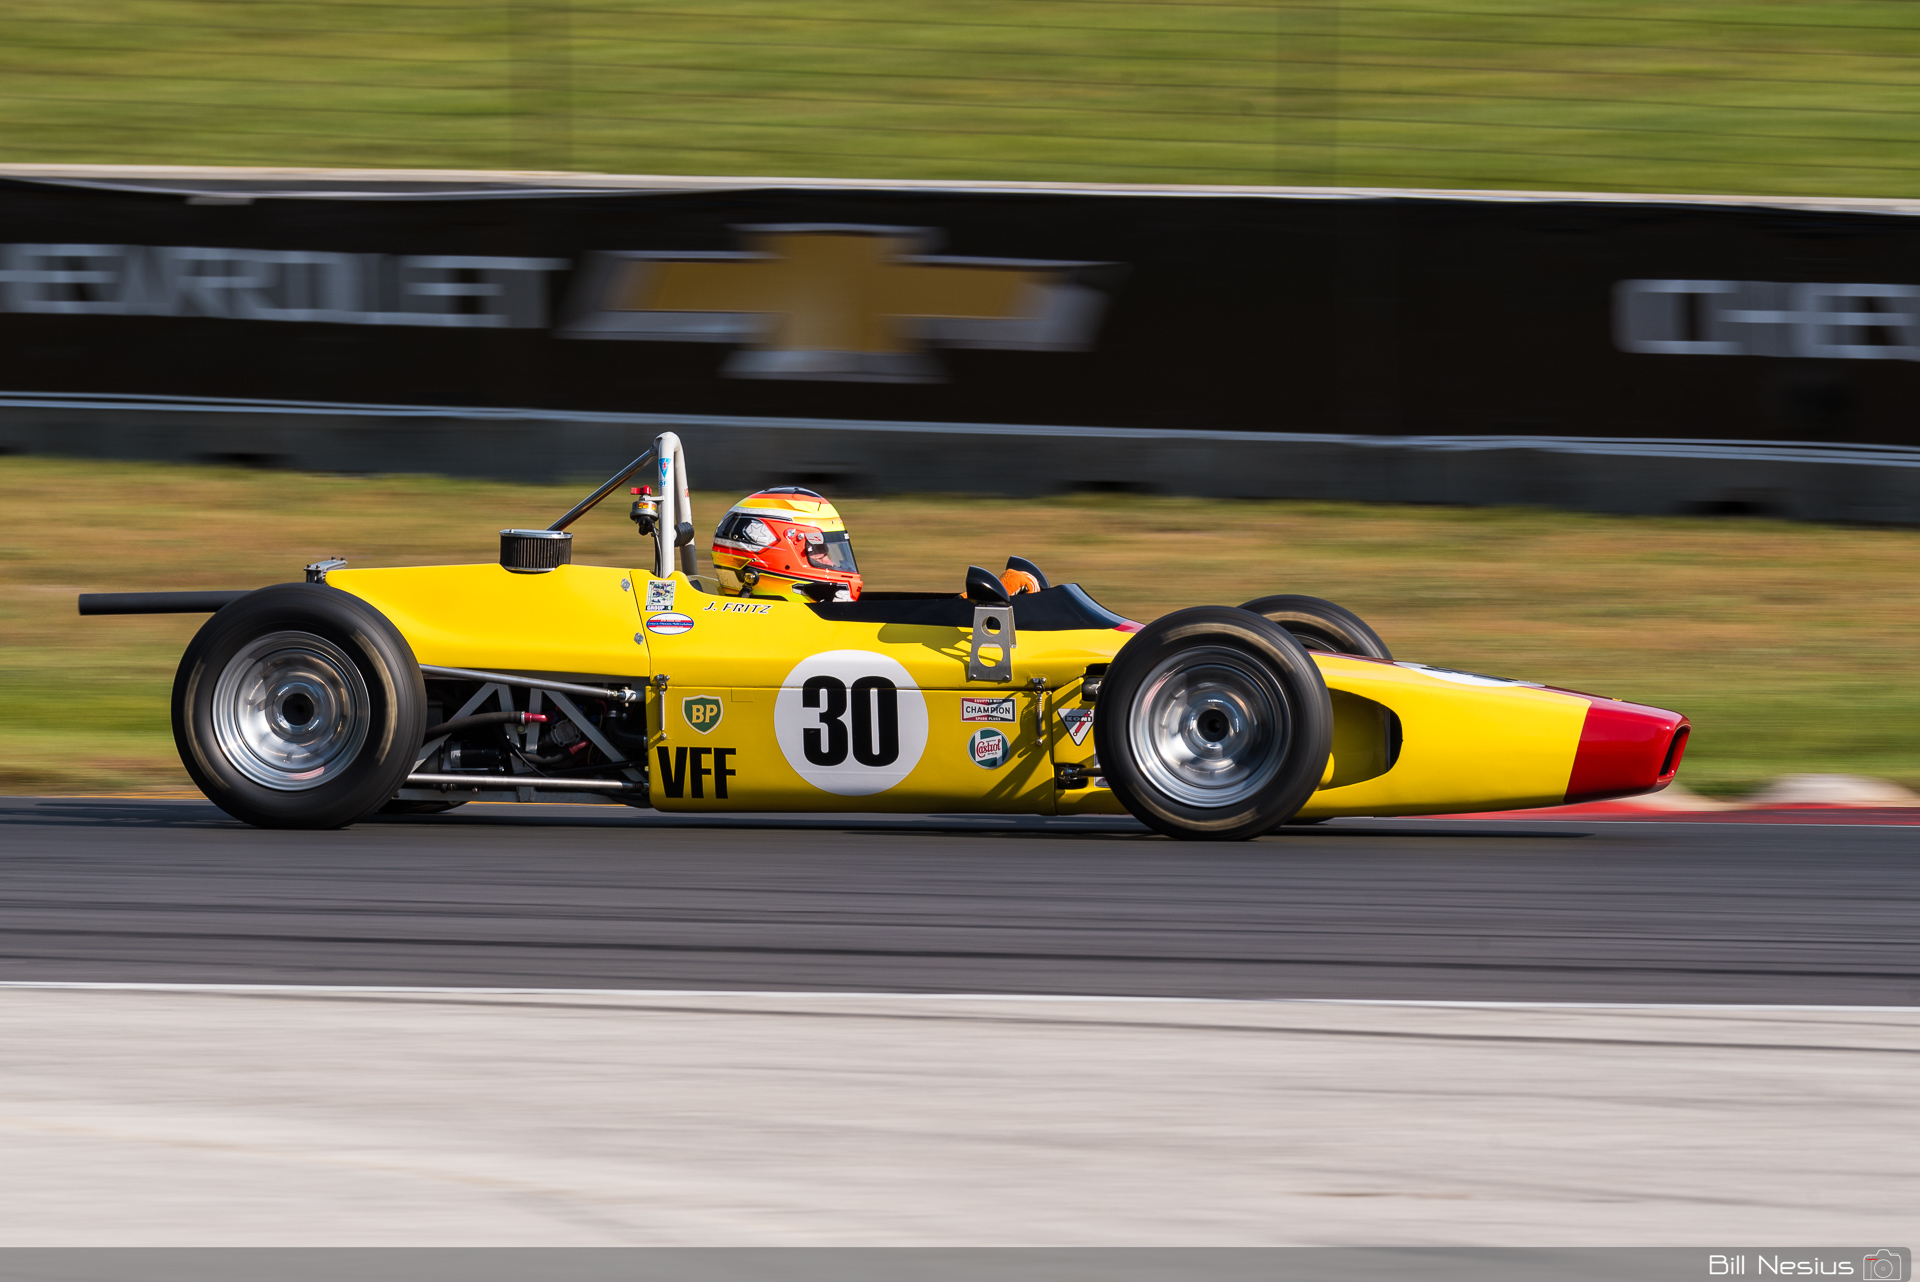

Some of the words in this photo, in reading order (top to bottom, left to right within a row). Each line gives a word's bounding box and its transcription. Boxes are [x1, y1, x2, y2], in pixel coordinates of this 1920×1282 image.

[703, 601, 717, 611] J.
[721, 602, 773, 614] FRITZ
[691, 704, 718, 724] BP
[965, 705, 1011, 715] CHAMPION
[802, 675, 900, 767] 30
[976, 738, 1002, 759] Castrol
[656, 746, 737, 799] VFF
